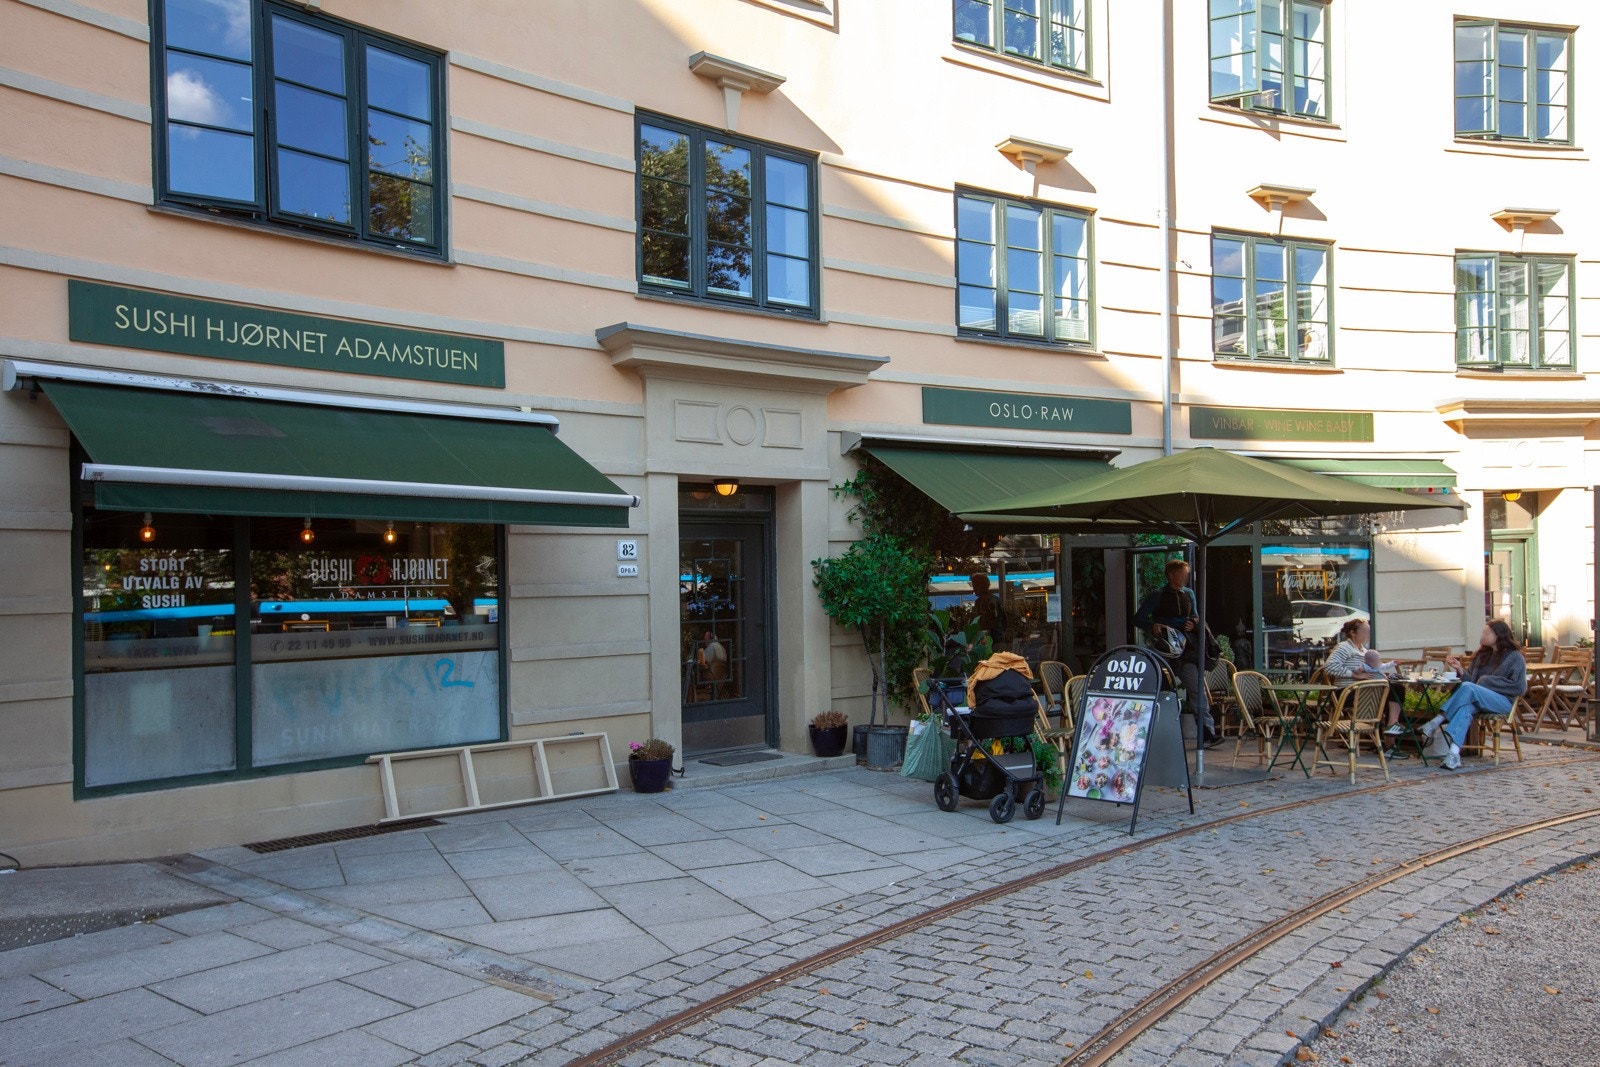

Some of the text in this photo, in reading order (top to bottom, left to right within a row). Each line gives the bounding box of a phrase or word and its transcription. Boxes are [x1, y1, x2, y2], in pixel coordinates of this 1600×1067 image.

[115, 304, 479, 371] SUSHI HJØRNET ADAMSTUEN
[1211, 416, 1255, 432] VINBAR
[1264, 418, 1293, 433] WINE
[1295, 419, 1323, 434] WINE
[1326, 420, 1355, 434] BABY
[622, 543, 635, 556] 82
[140, 558, 187, 572] STORT
[311, 558, 449, 582] SUSHI HJØRNET
[123, 575, 203, 591] UTVALG AV
[142, 594, 186, 609] SUSHI
[329, 589, 434, 600] ADAMSTUEN
[287, 640, 301, 651] 22
[305, 639, 317, 650] 11
[1107, 655, 1147, 674] oslo
[1103, 675, 1144, 690] raw
